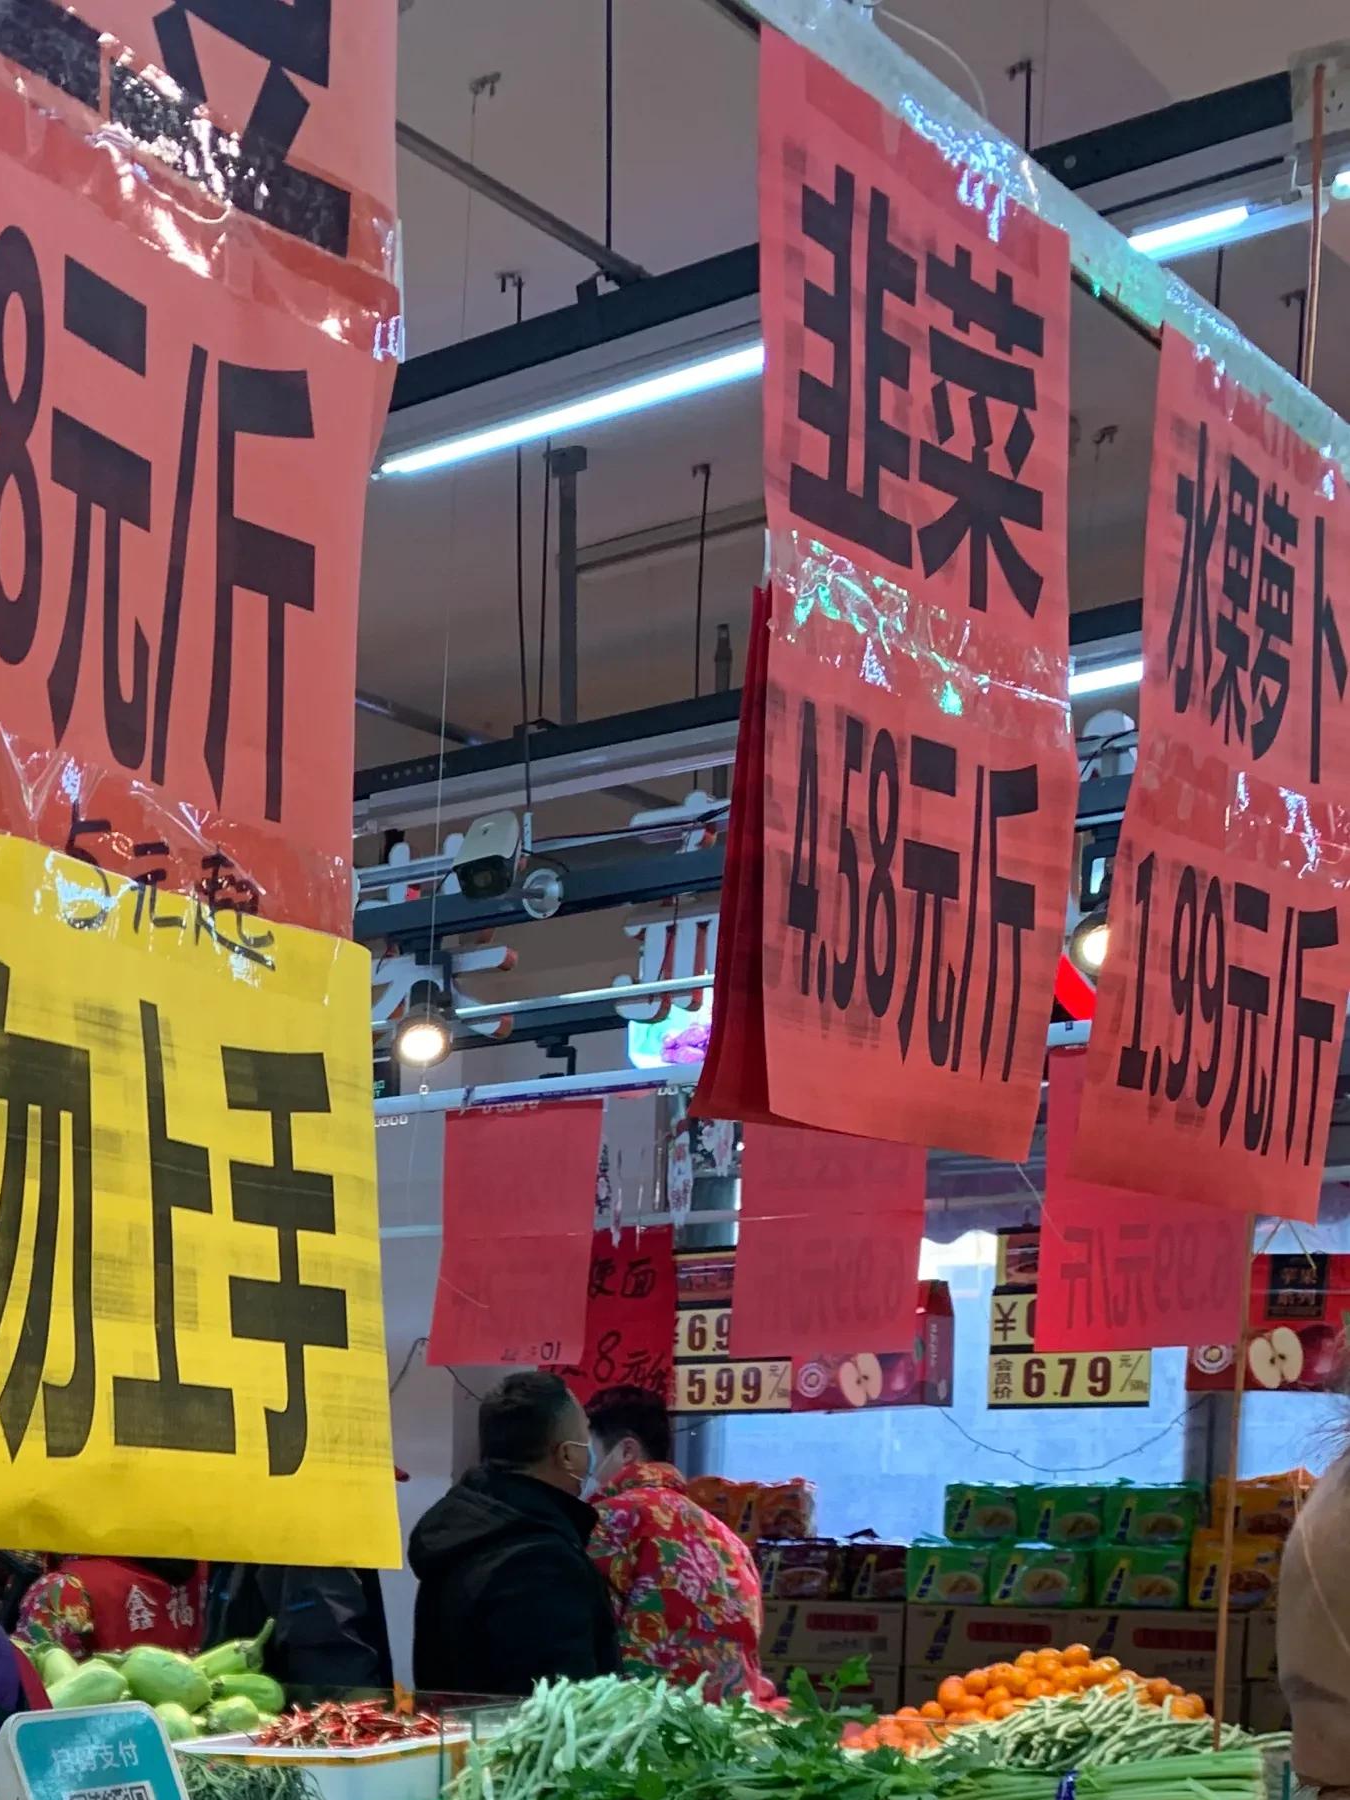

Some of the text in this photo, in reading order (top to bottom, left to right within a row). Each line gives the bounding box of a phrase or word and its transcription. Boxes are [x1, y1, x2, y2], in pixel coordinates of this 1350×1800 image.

[789, 164, 1044, 619] 韭菜
[1167, 420, 1347, 784] 水果萝卜
[787, 700, 1039, 1082] 4.58元/斤
[1117, 851, 1338, 1166] 1.99元/斤
